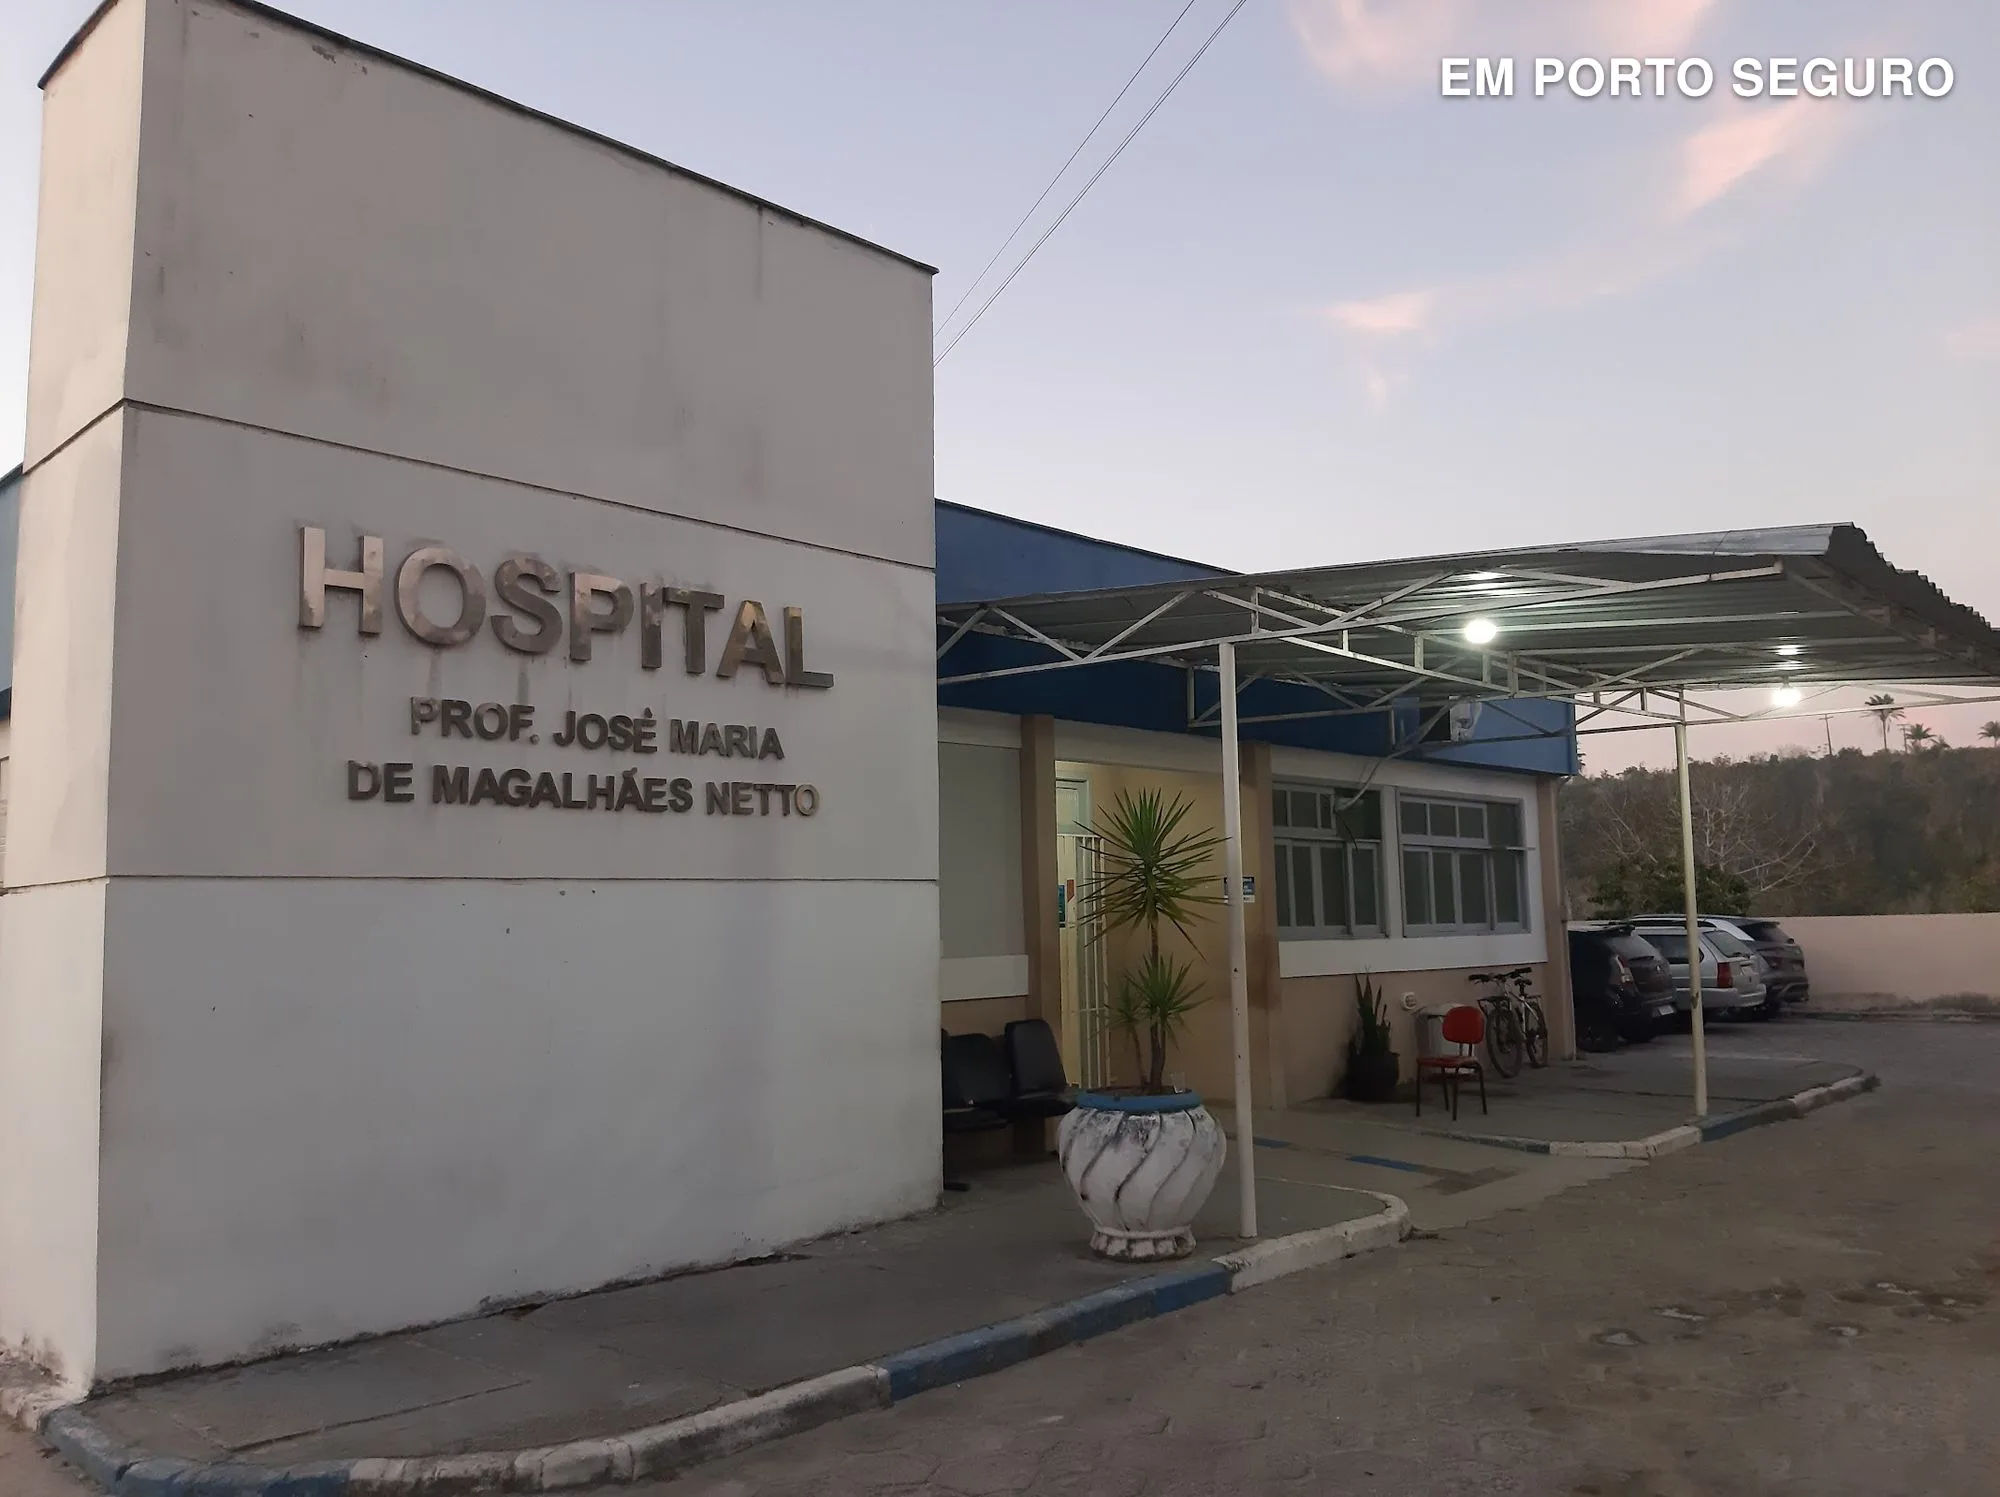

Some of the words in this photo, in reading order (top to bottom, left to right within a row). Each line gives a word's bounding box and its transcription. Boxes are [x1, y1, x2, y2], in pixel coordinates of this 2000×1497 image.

[298, 526, 834, 688] HOSPITAL
[410, 697, 539, 744] PROF.
[669, 719, 785, 760] MARIA
[347, 760, 414, 802] DE
[706, 781, 820, 816] NETTO
